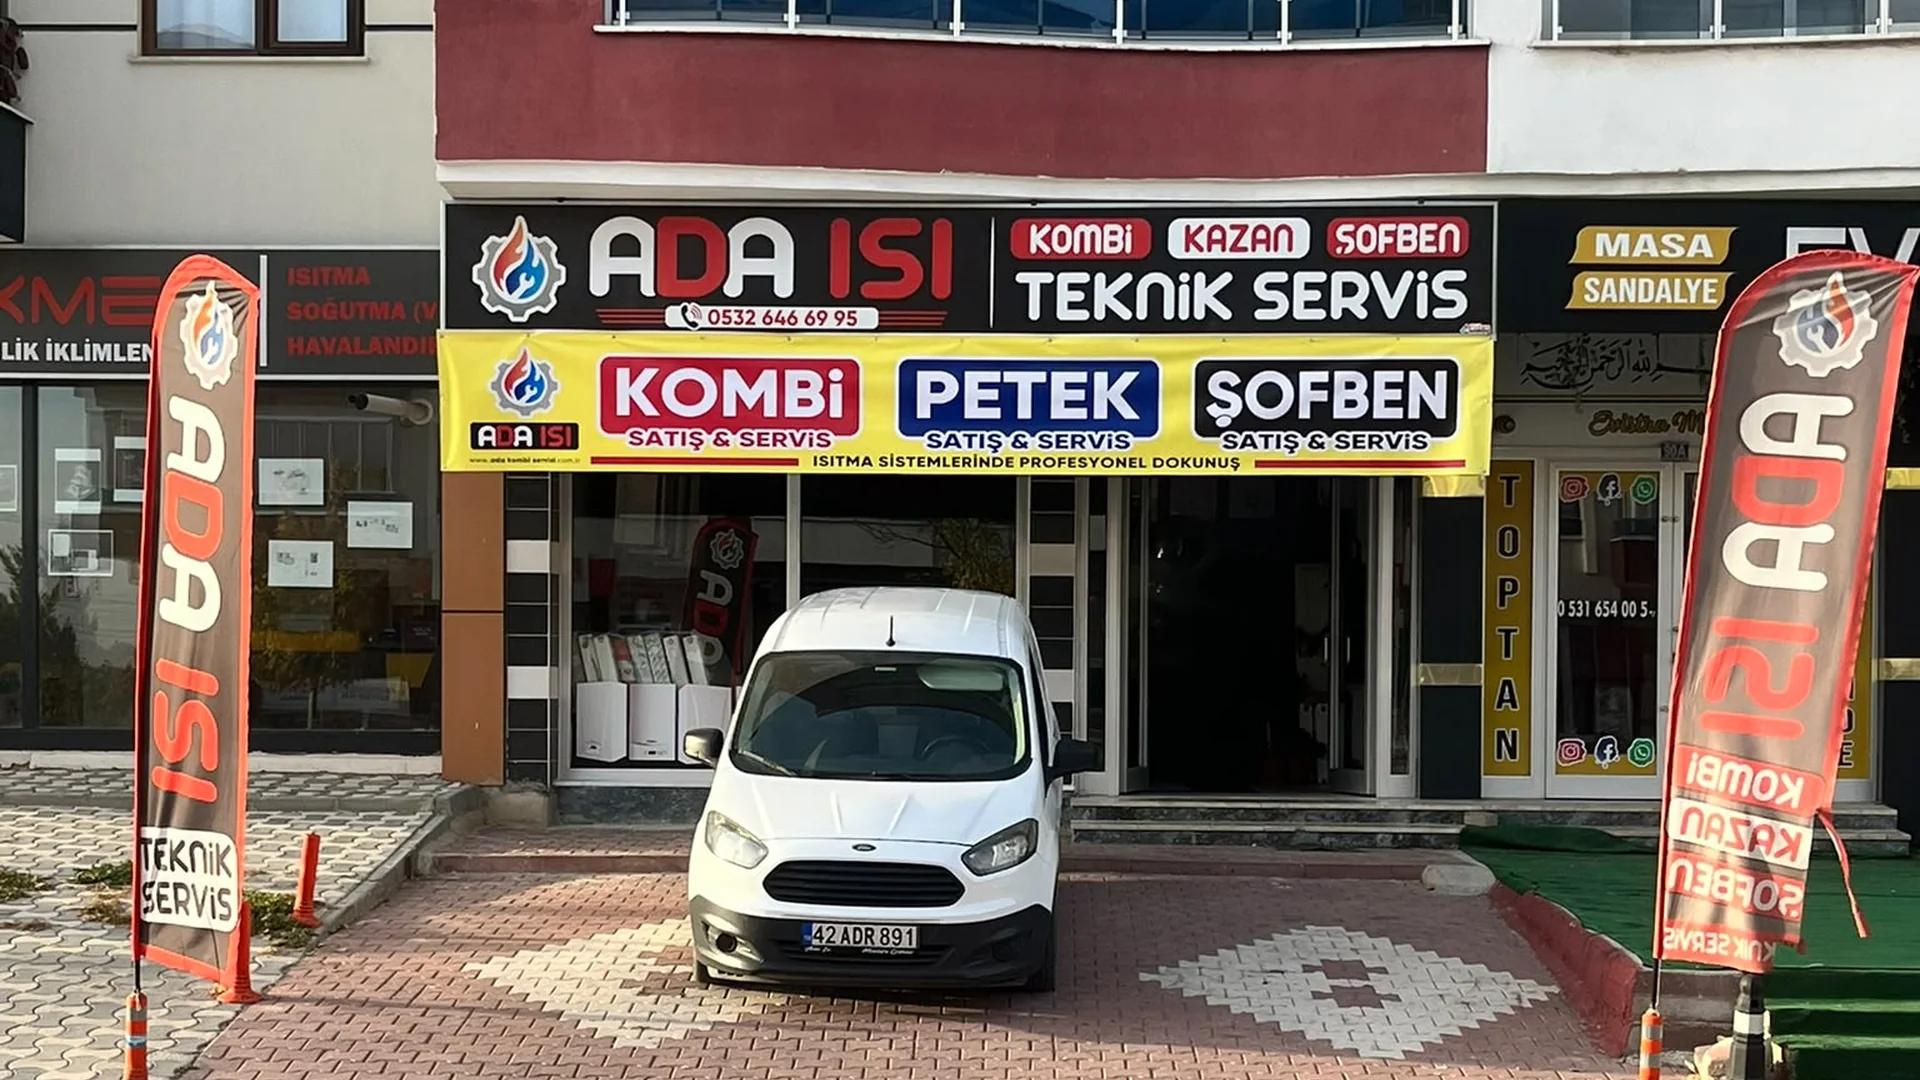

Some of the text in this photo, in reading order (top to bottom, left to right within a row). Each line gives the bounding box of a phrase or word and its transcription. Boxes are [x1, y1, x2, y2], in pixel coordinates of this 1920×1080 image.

[1183, 223, 1294, 253] KAZAN
[1334, 223, 1461, 255] ŞOFBEN
[1594, 233, 1714, 258] MASA
[588, 216, 953, 300] ADA ISI
[286, 266, 371, 287] ISITMA
[1583, 277, 1718, 304] SANDALYE
[286, 297, 407, 321] SOĞUTMA
[707, 308, 858, 327] 0532 646 69 95
[915, 370, 1141, 420] PETEK
[1205, 369, 1448, 428] ŞOFBEN
[478, 425, 572, 447] ADA ISI
[628, 430, 705, 451] SATIŞ
[712, 431, 730, 448] &
[925, 432, 1003, 453] SATIŞ
[1010, 433, 1029, 449] &
[1221, 433, 1299, 454] SATIŞ
[1307, 434, 1325, 450] &
[812, 453, 1241, 471] ISITMA SİSTEMLERİNDE PROFESYONEL DOKUNUŞ
[151, 395, 226, 803] ADA ISI
[1568, 600, 1591, 618] 531
[1594, 600, 1618, 618] 654
[1621, 600, 1637, 618] 00
[1494, 474, 1521, 763] TOPTAN
[813, 925, 914, 947] 42 ADR 891
